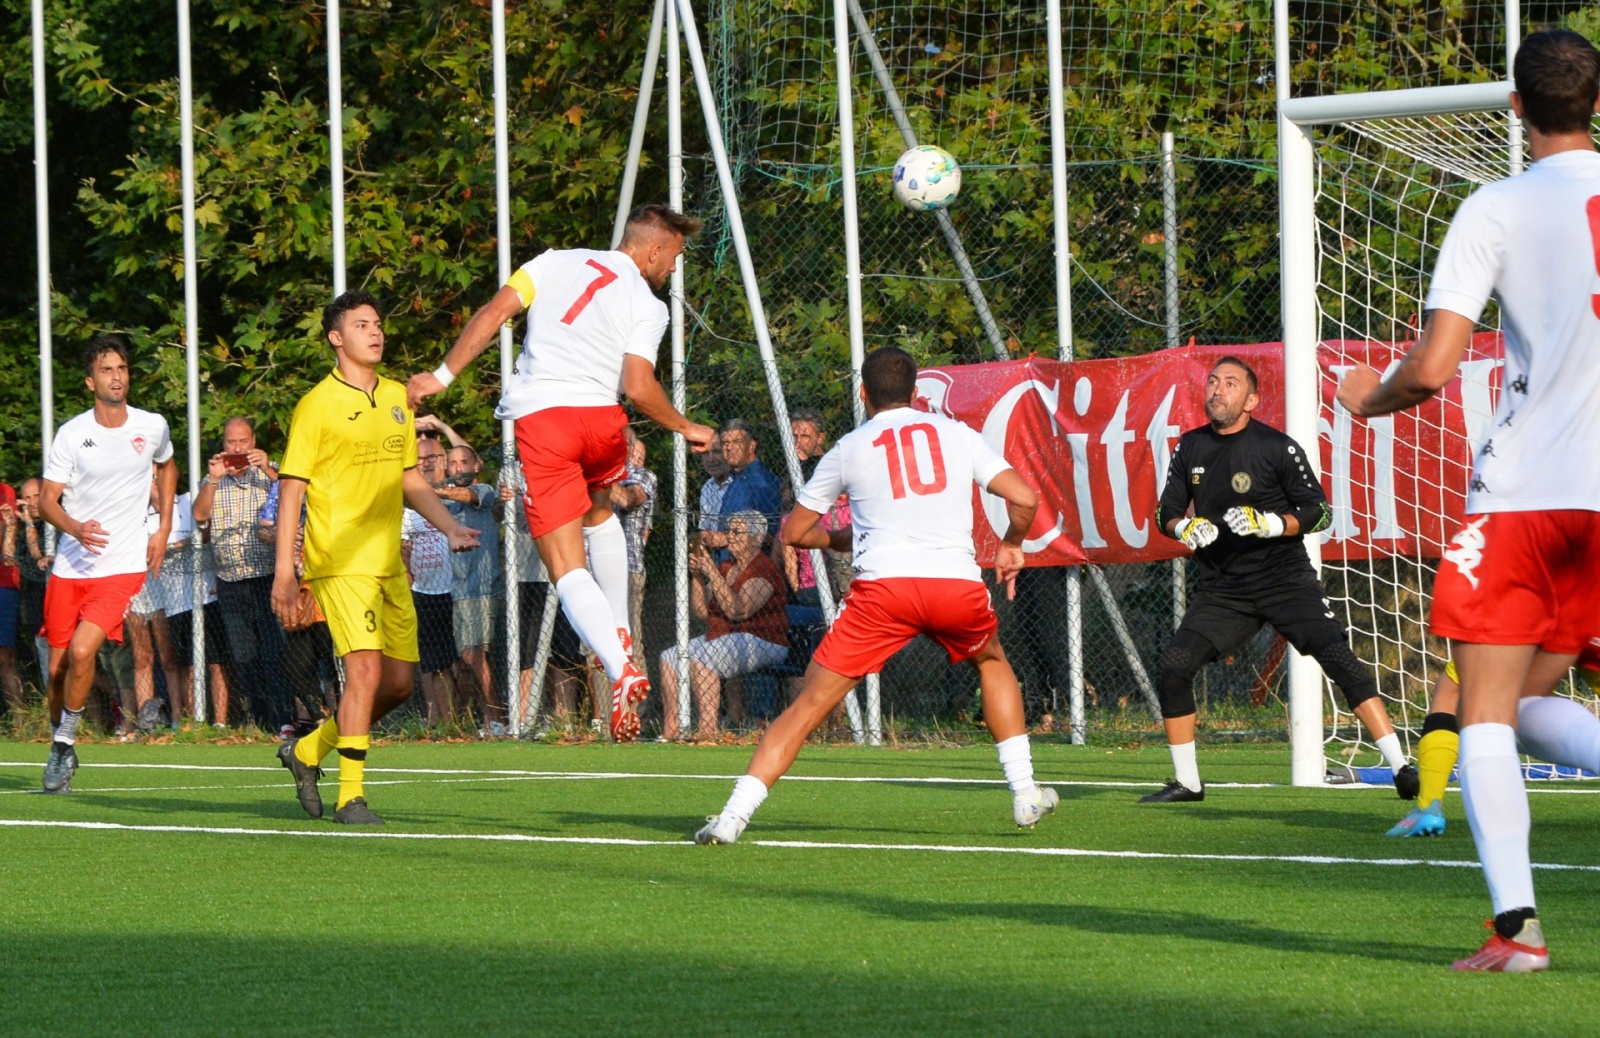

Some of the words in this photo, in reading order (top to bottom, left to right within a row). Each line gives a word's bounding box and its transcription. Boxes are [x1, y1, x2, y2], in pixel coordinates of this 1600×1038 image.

[560, 258, 619, 326] 7
[872, 422, 948, 500] 10
[979, 376, 1181, 553] Citt
[364, 609, 377, 633] 3
